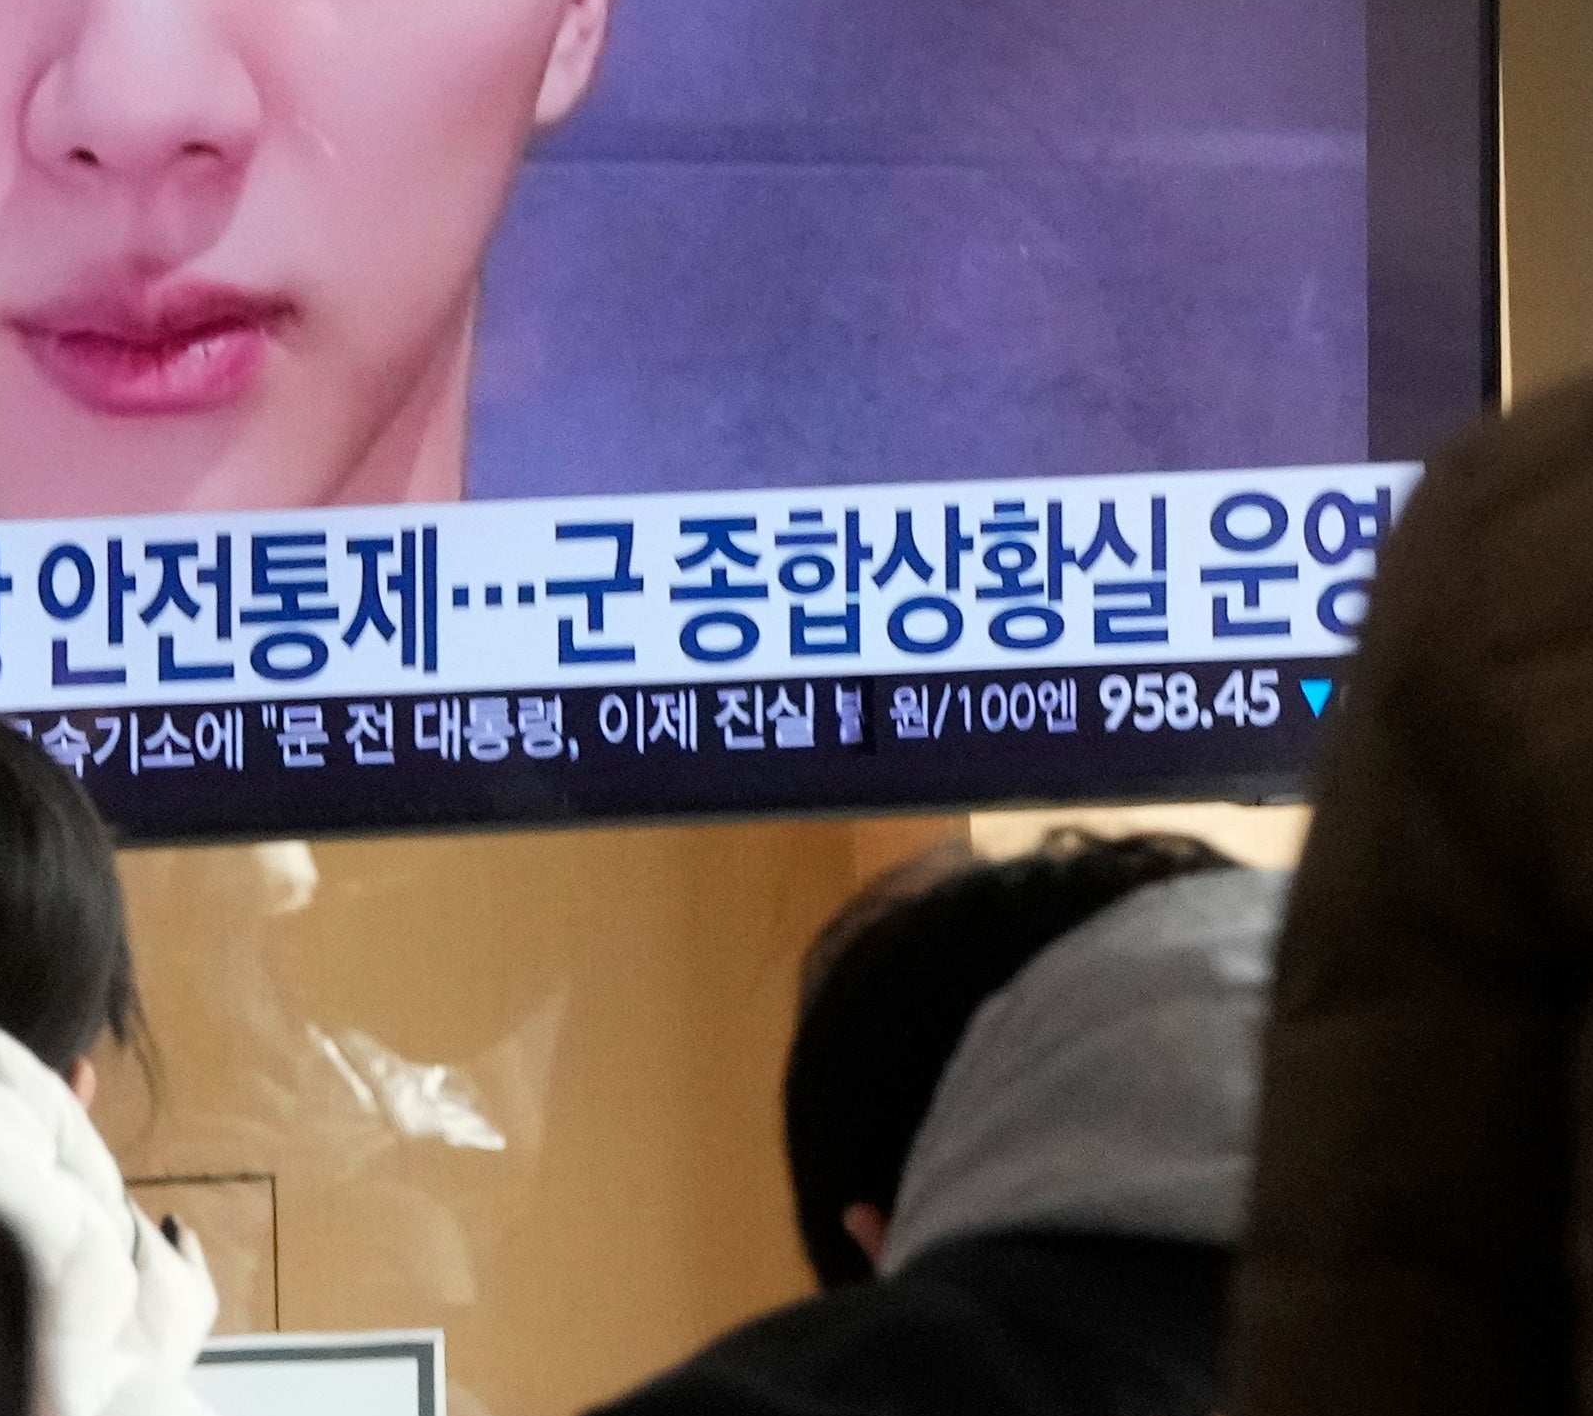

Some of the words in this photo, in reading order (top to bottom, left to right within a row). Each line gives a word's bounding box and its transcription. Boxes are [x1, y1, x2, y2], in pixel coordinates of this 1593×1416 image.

[668, 493, 1169, 655] 종합상황실
[345, 700, 396, 765] 전
[414, 693, 580, 763] 대통령,
[598, 688, 699, 755] 이제
[713, 682, 816, 751] 진실
[1099, 668, 1281, 733] 958.45
